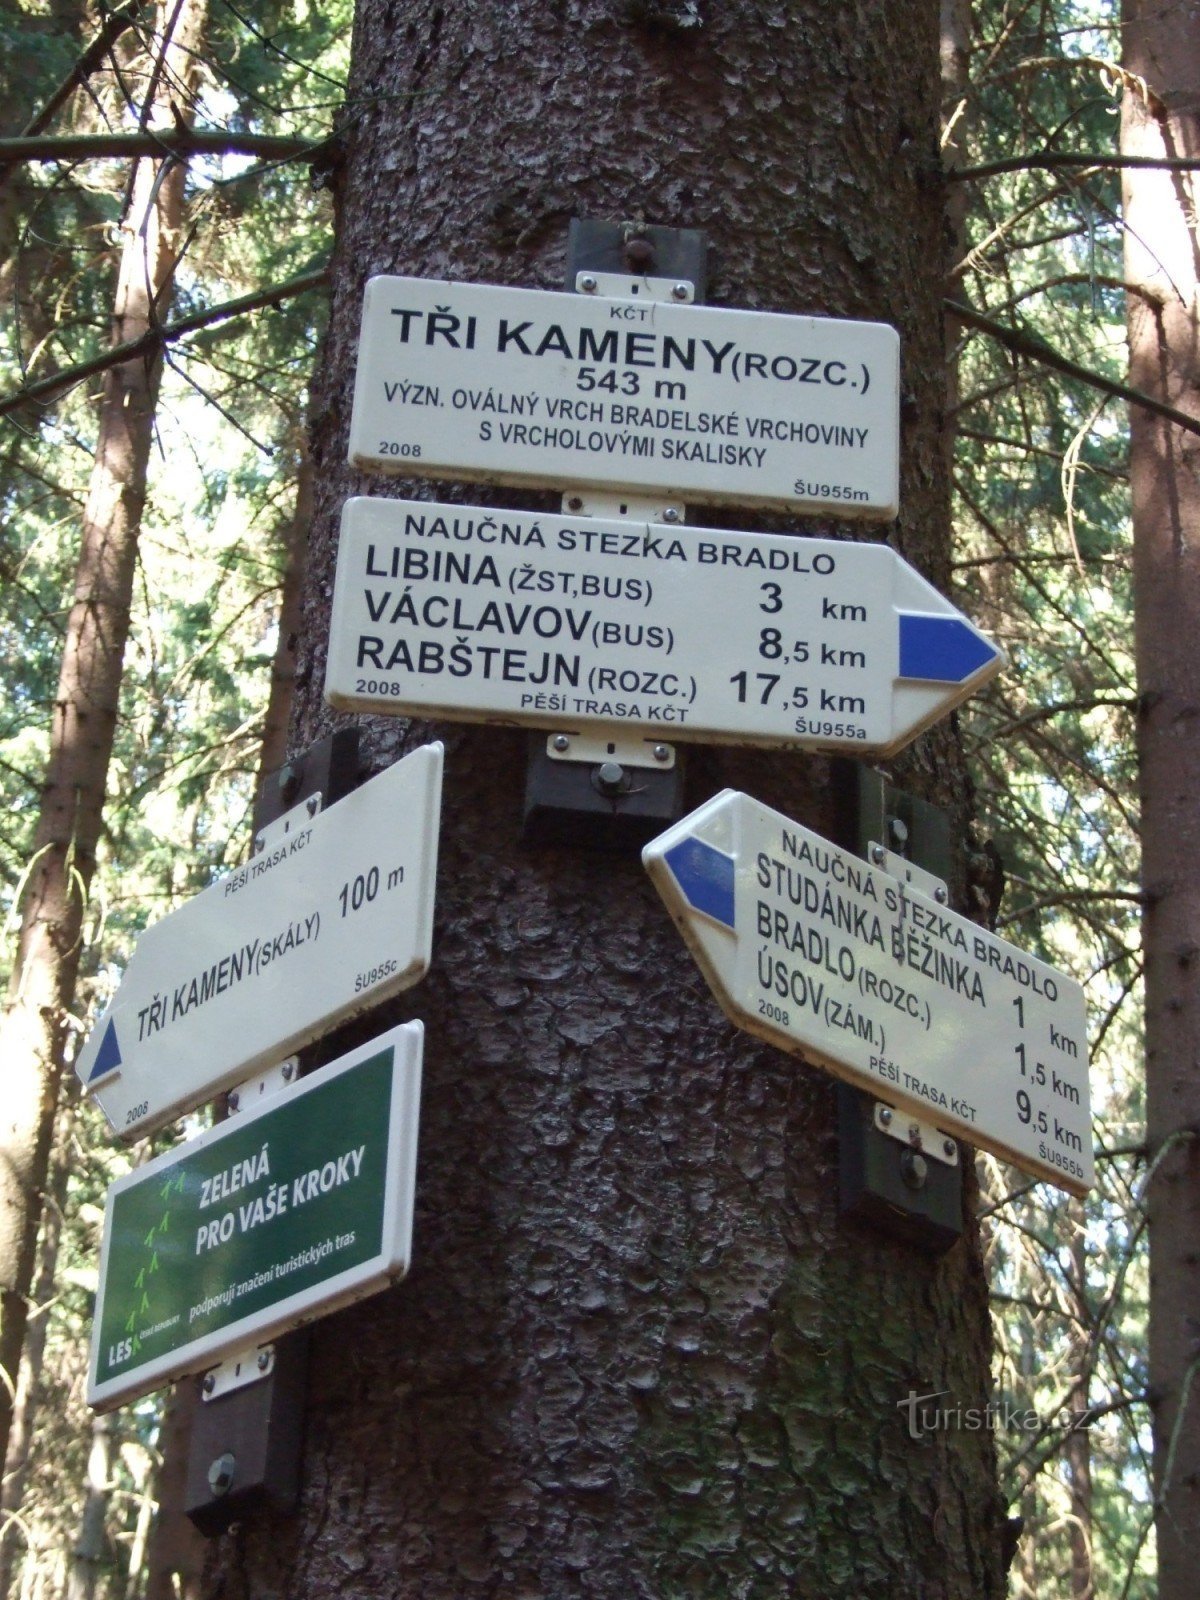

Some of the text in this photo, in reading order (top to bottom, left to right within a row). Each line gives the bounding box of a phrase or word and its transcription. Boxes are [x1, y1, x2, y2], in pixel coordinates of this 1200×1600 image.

[391, 306, 476, 349] TŘI
[610, 304, 649, 322] KČT
[576, 367, 687, 400] 543 m
[384, 379, 869, 449] VÝZN. OVÁLNÝ VRCH BRADELSKÉ VRCHOVINY
[379, 441, 422, 458] 2008
[480, 422, 767, 468] S VRCHOLOVÝMI SKALISKY
[794, 480, 870, 501] ŠU955m
[404, 514, 836, 576] NAUČNÁ STEZKA BRADLO
[759, 582, 782, 614] 3
[821, 597, 867, 623] km
[757, 628, 810, 666] 8,5
[820, 643, 866, 669] km
[356, 680, 400, 697] 2008
[520, 690, 689, 723] PĚŠÍ TRASA KČT
[729, 671, 809, 713] 17,5
[819, 689, 866, 715] km
[795, 716, 867, 740] ŠU955a
[224, 829, 313, 898] PĚŠÍ TRASA KČT
[782, 829, 1058, 1003] NAUČNÁ STEZKA BRADLO
[137, 994, 169, 1041] TŘI
[339, 865, 380, 917] 100
[387, 864, 404, 893] m
[757, 852, 1078, 1058] STUDÁNKA BĚŽINKA 1 km
[354, 958, 398, 993] ŠU955c
[758, 999, 790, 1026] 2008
[869, 1054, 978, 1123] PĚŠÍ TRASA KČT
[1014, 1043, 1046, 1086] 1,5
[1052, 1070, 1080, 1105] km
[126, 1101, 149, 1125] 2008
[1016, 1089, 1048, 1134] 9,5
[1054, 1118, 1082, 1153] km
[199, 1142, 270, 1209] ZELENÁ
[1038, 1141, 1084, 1180] ŠU955b
[196, 1145, 366, 1255] PRO VAŠE KROKY
[189, 1231, 356, 1323] podporují značení turistických tras
